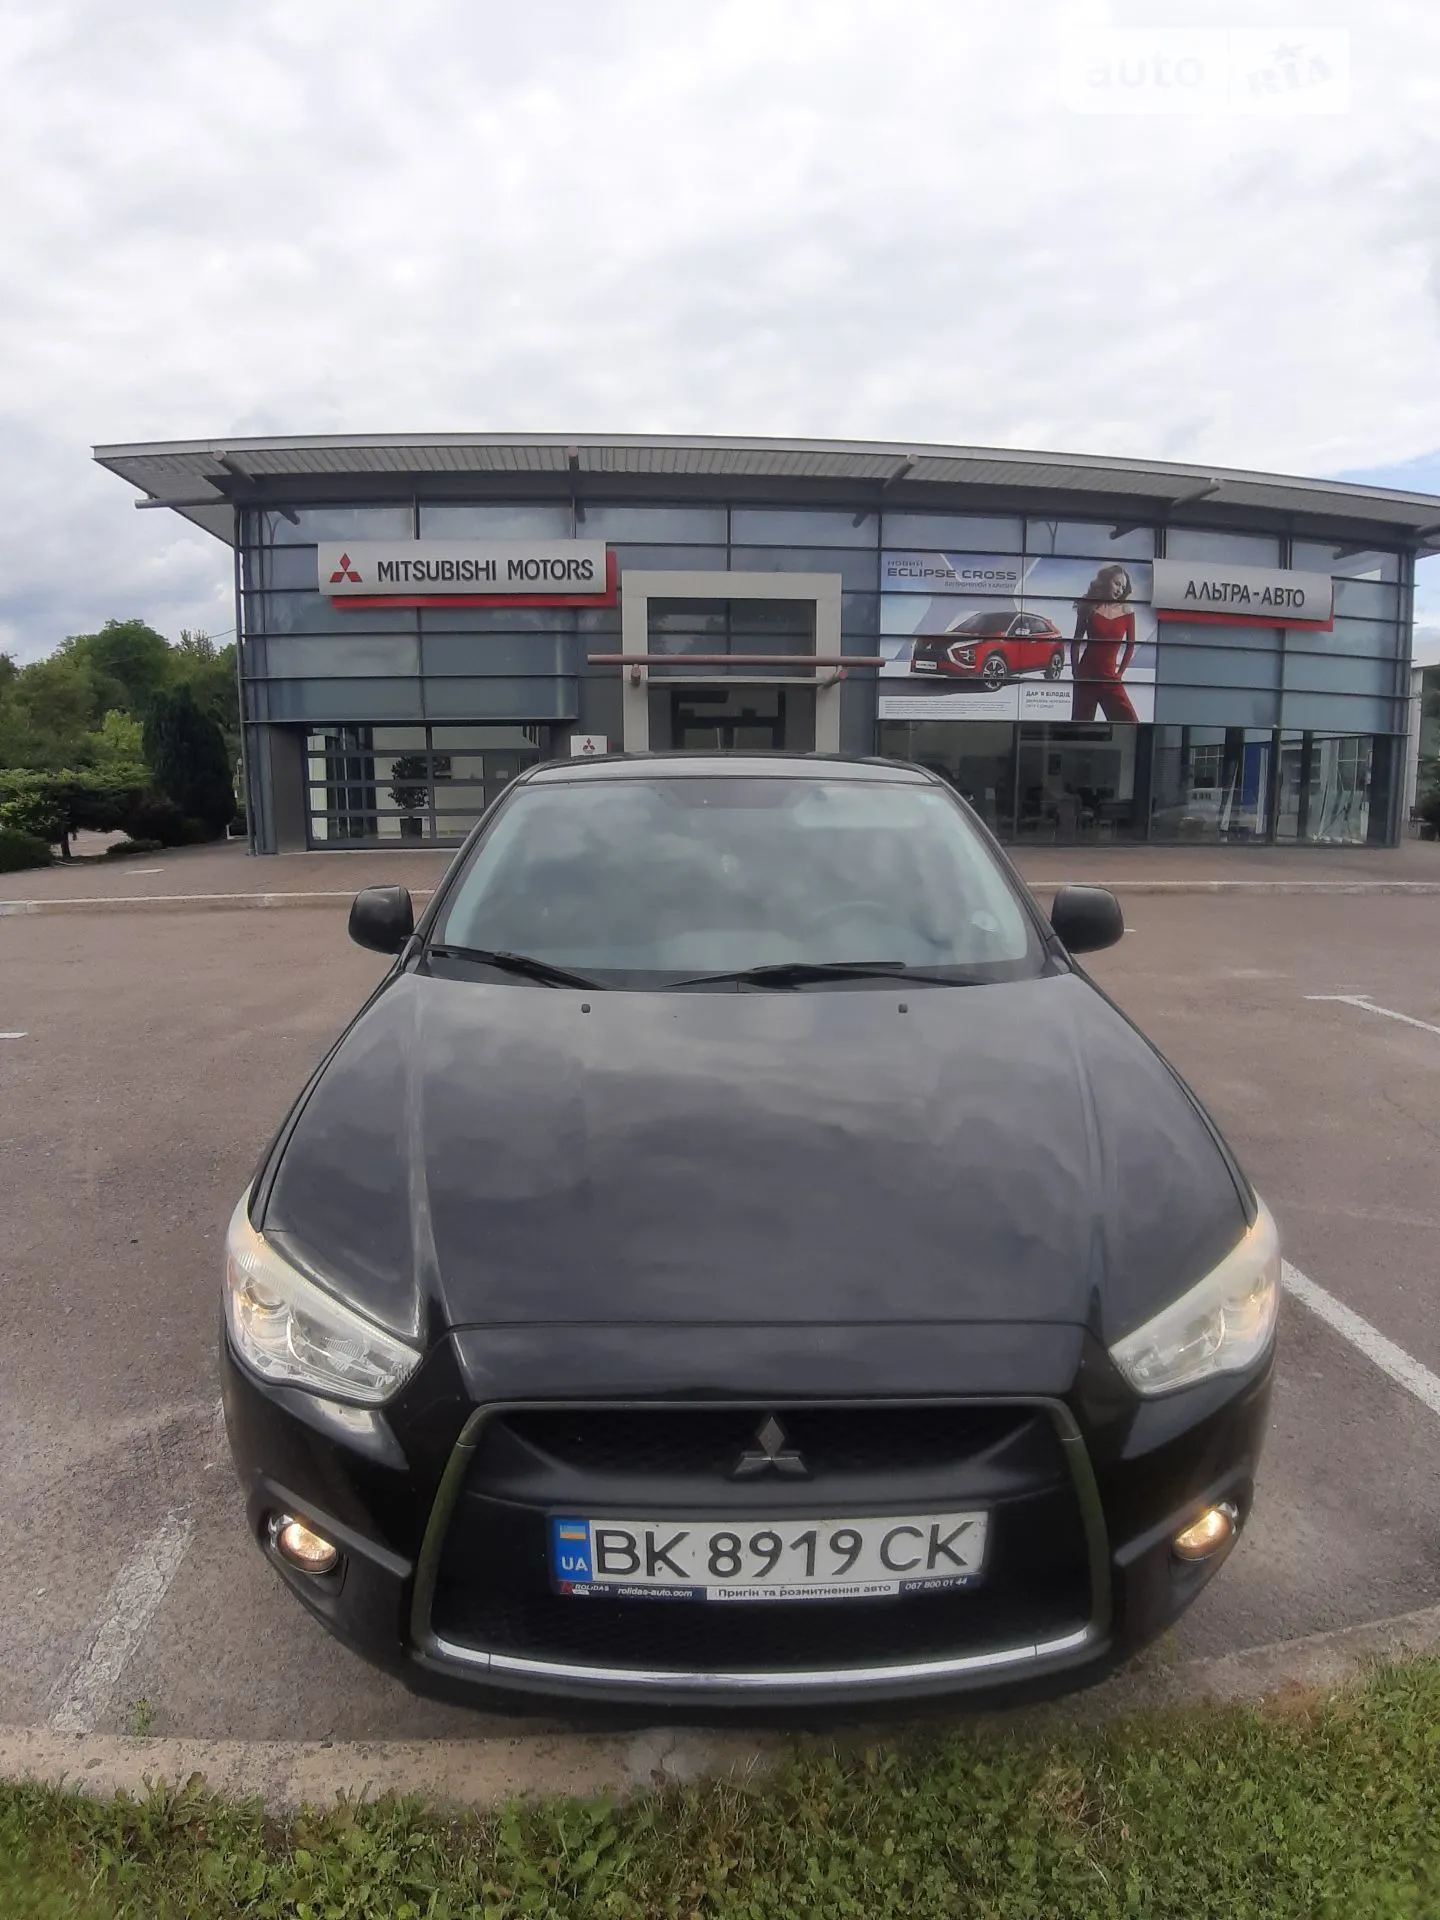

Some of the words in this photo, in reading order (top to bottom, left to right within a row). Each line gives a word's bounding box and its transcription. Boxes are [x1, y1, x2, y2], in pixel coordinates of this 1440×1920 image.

[377, 560, 497, 582] MITSUBISHI
[507, 559, 594, 581] MOTORS
[887, 568, 957, 579] ECLIPSE
[961, 570, 1018, 581] CROSS
[1184, 580, 1305, 608] АЛЬТРА-АВТО
[594, 1529, 691, 1578] BK
[707, 1528, 864, 1578] 8919
[879, 1521, 975, 1572] CK
[561, 1555, 589, 1573] UA
[617, 1587, 693, 1598] rolidas-auto.com
[718, 1588, 760, 1599] Пригін
[763, 1588, 776, 1597] та
[780, 1586, 860, 1598] розмитнення
[863, 1584, 892, 1594] авто
[905, 1582, 921, 1591] 067
[923, 1581, 941, 1589] 800
[943, 1579, 955, 1588] 01
[955, 1578, 968, 1586] 44
